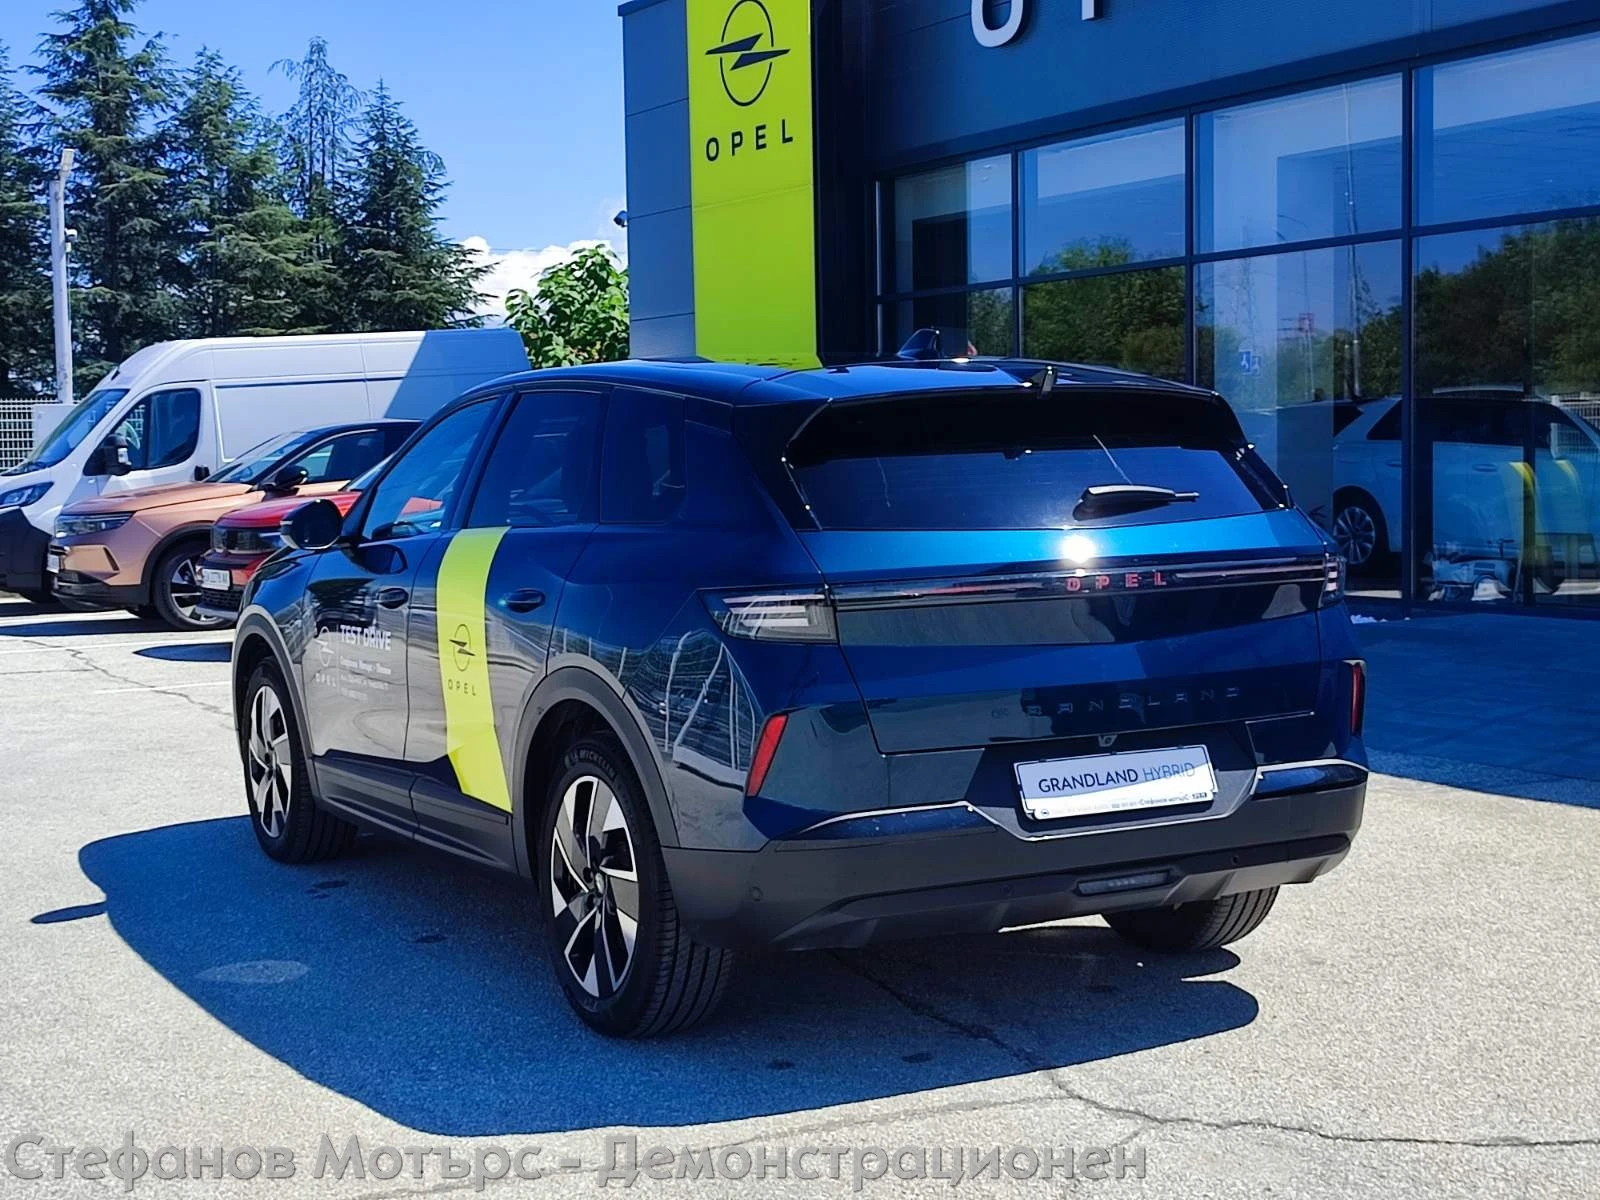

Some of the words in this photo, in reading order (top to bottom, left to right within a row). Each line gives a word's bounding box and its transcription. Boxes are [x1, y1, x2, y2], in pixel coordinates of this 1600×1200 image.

[971, 0, 1095, 48] O
[706, 118, 794, 162] OPEL
[1066, 572, 1167, 592] OPEL
[340, 624, 362, 645] TEST
[363, 625, 391, 651] DRIVE
[447, 678, 476, 697] OPEL
[1038, 768, 1138, 793] GRANDLAND
[1142, 762, 1196, 782] HYBRID
